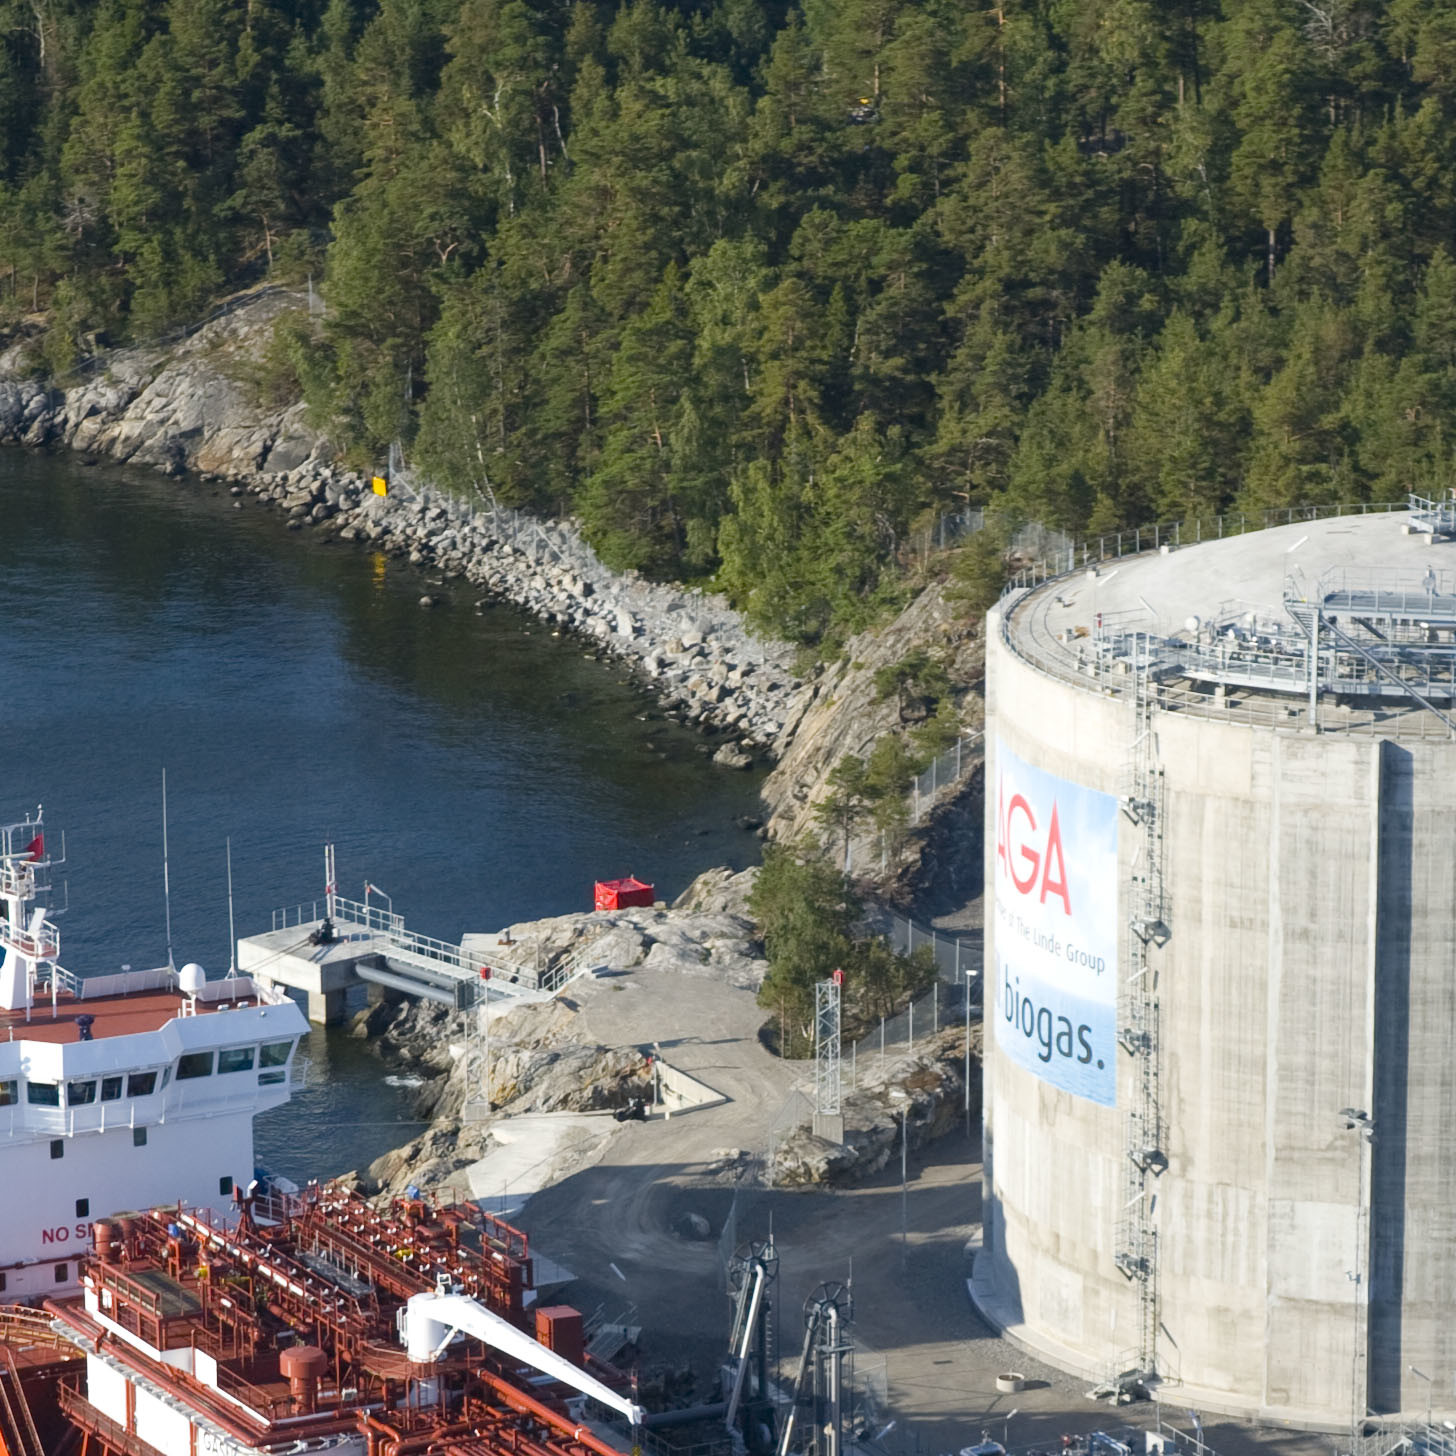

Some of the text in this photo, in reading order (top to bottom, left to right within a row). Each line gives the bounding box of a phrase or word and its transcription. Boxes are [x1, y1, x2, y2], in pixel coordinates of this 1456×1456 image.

[997, 767, 1072, 917] AGA
[1016, 916, 1031, 941] The
[1033, 927, 1062, 957] Linde
[1066, 943, 1106, 976] Group
[1005, 963, 1105, 1070] biogas.
[42, 1226, 70, 1245] NO
